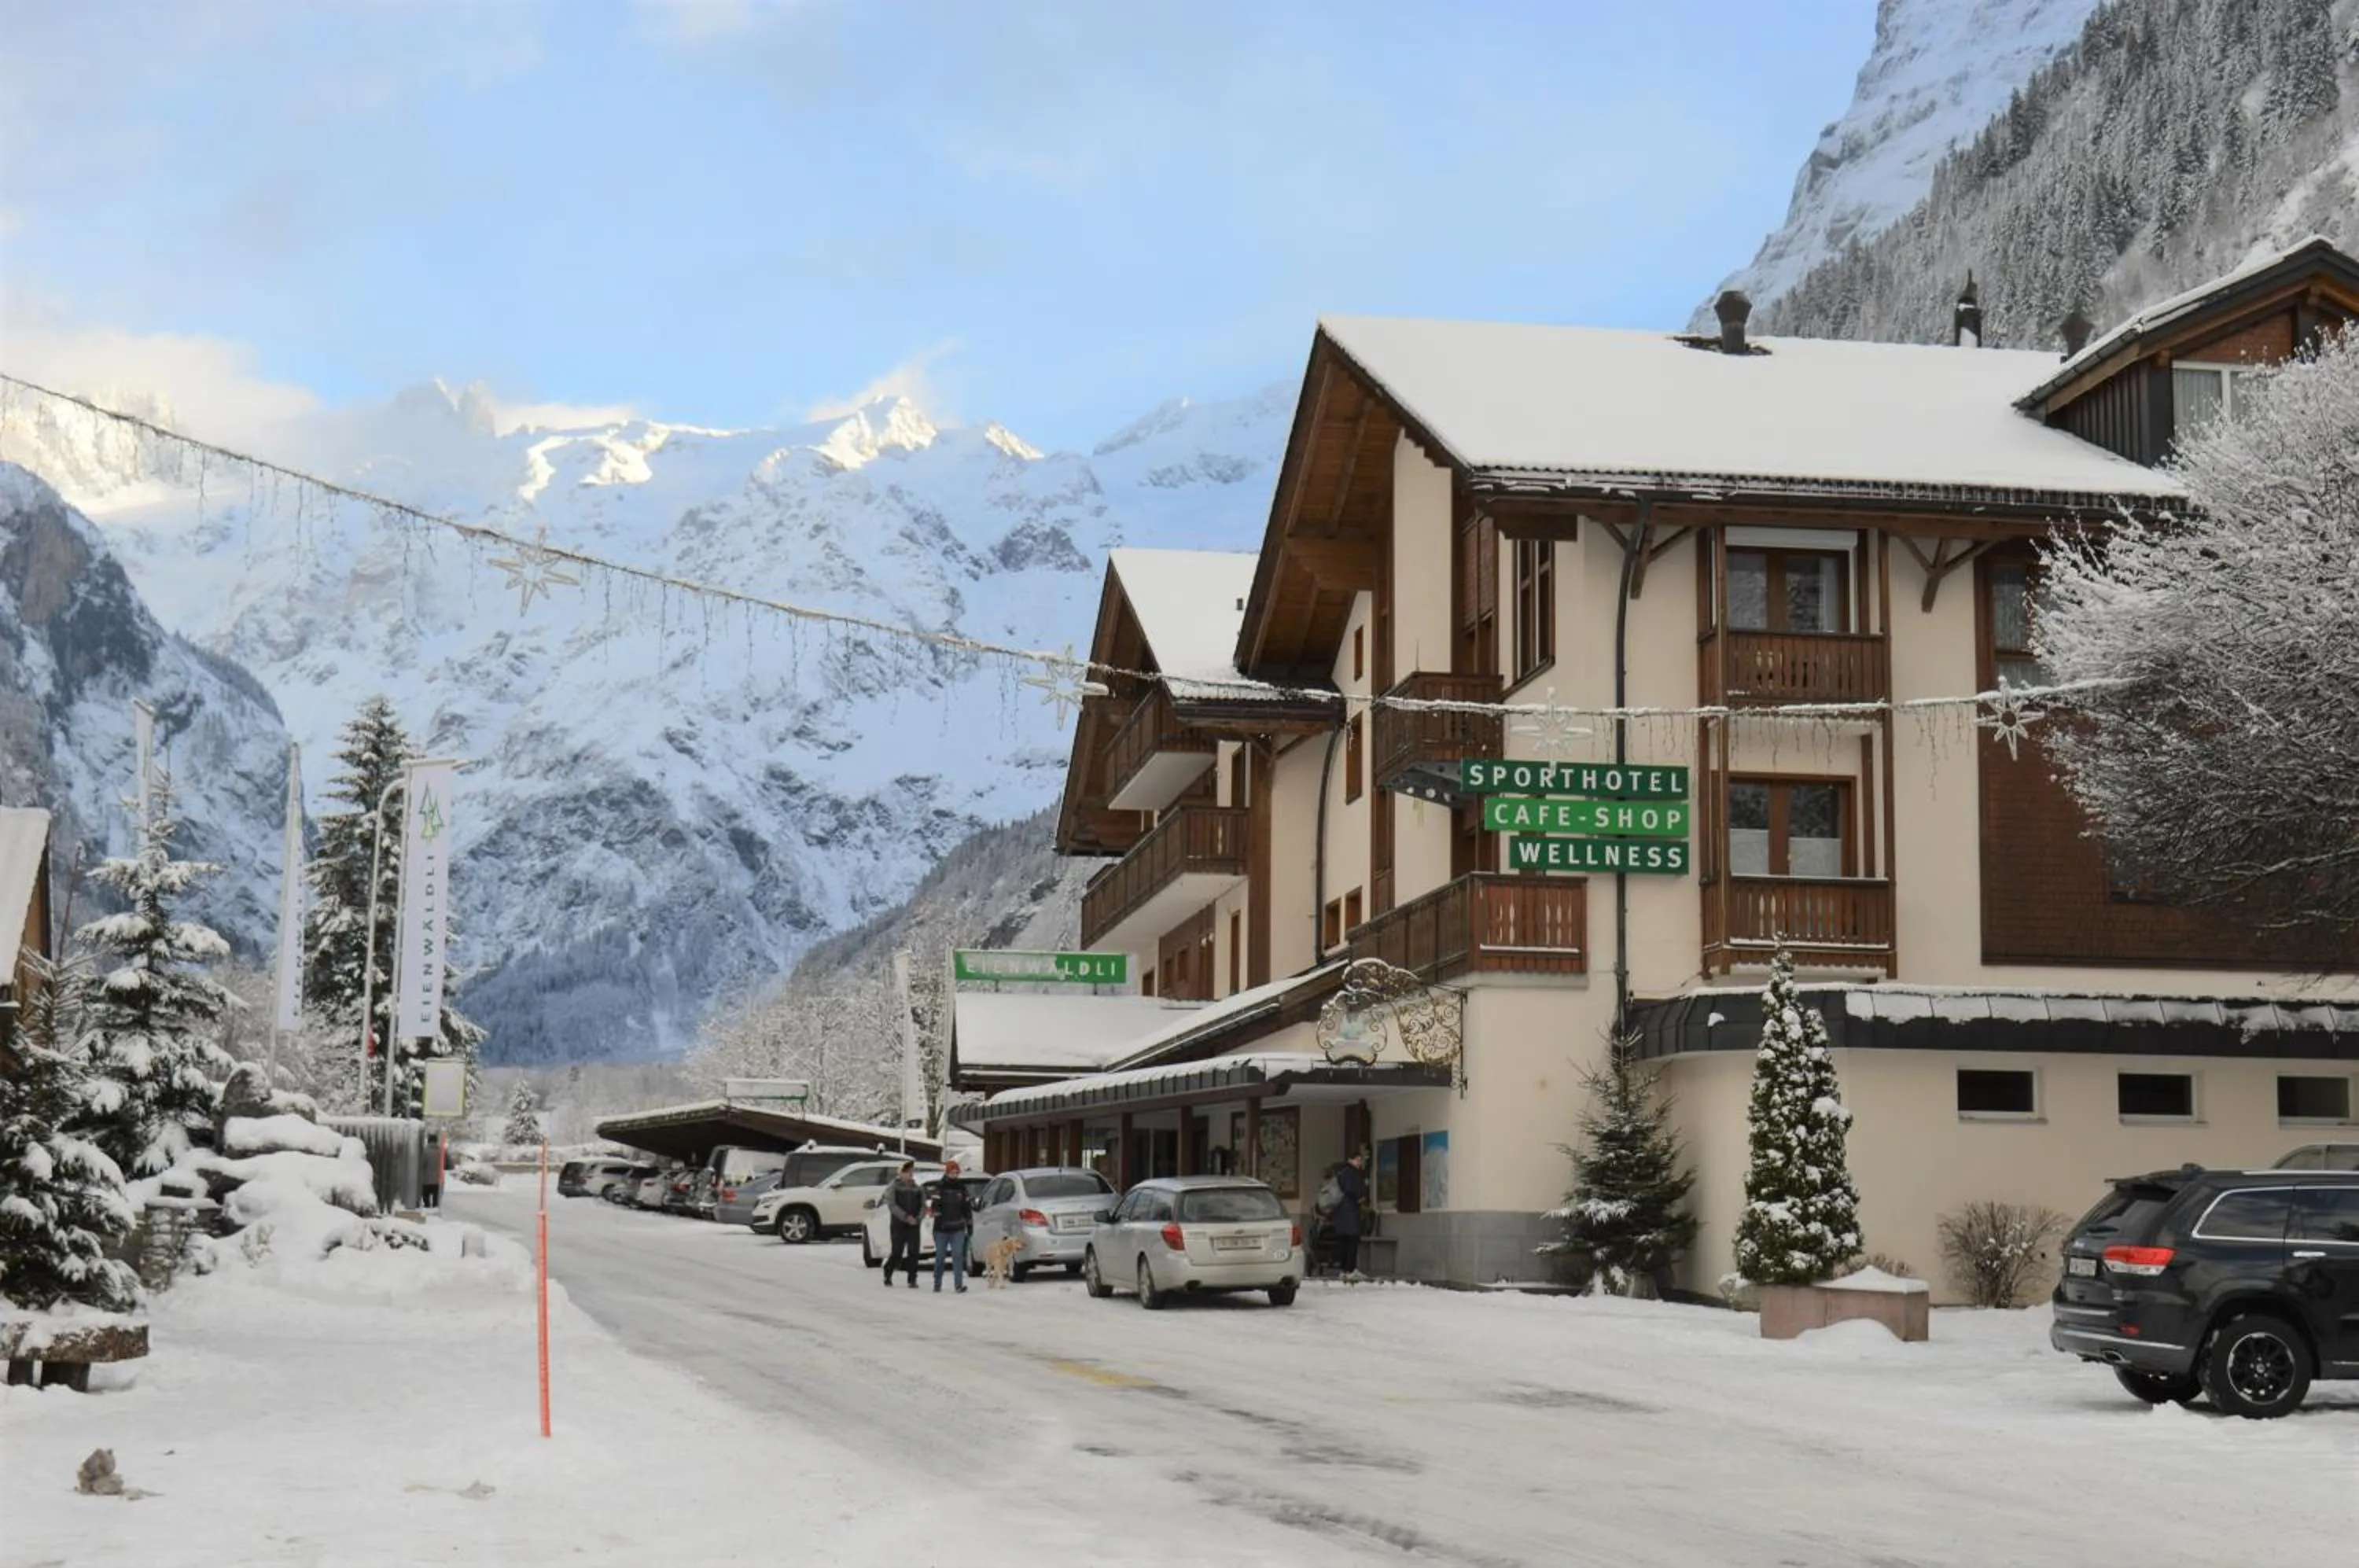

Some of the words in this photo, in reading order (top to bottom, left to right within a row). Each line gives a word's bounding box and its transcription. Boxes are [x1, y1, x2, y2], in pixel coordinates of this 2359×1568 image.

[1468, 764, 1684, 793] SPORTHOTEL
[1494, 803, 1681, 830] CAFE-SHOP
[1518, 842, 1683, 868] WELLNESS
